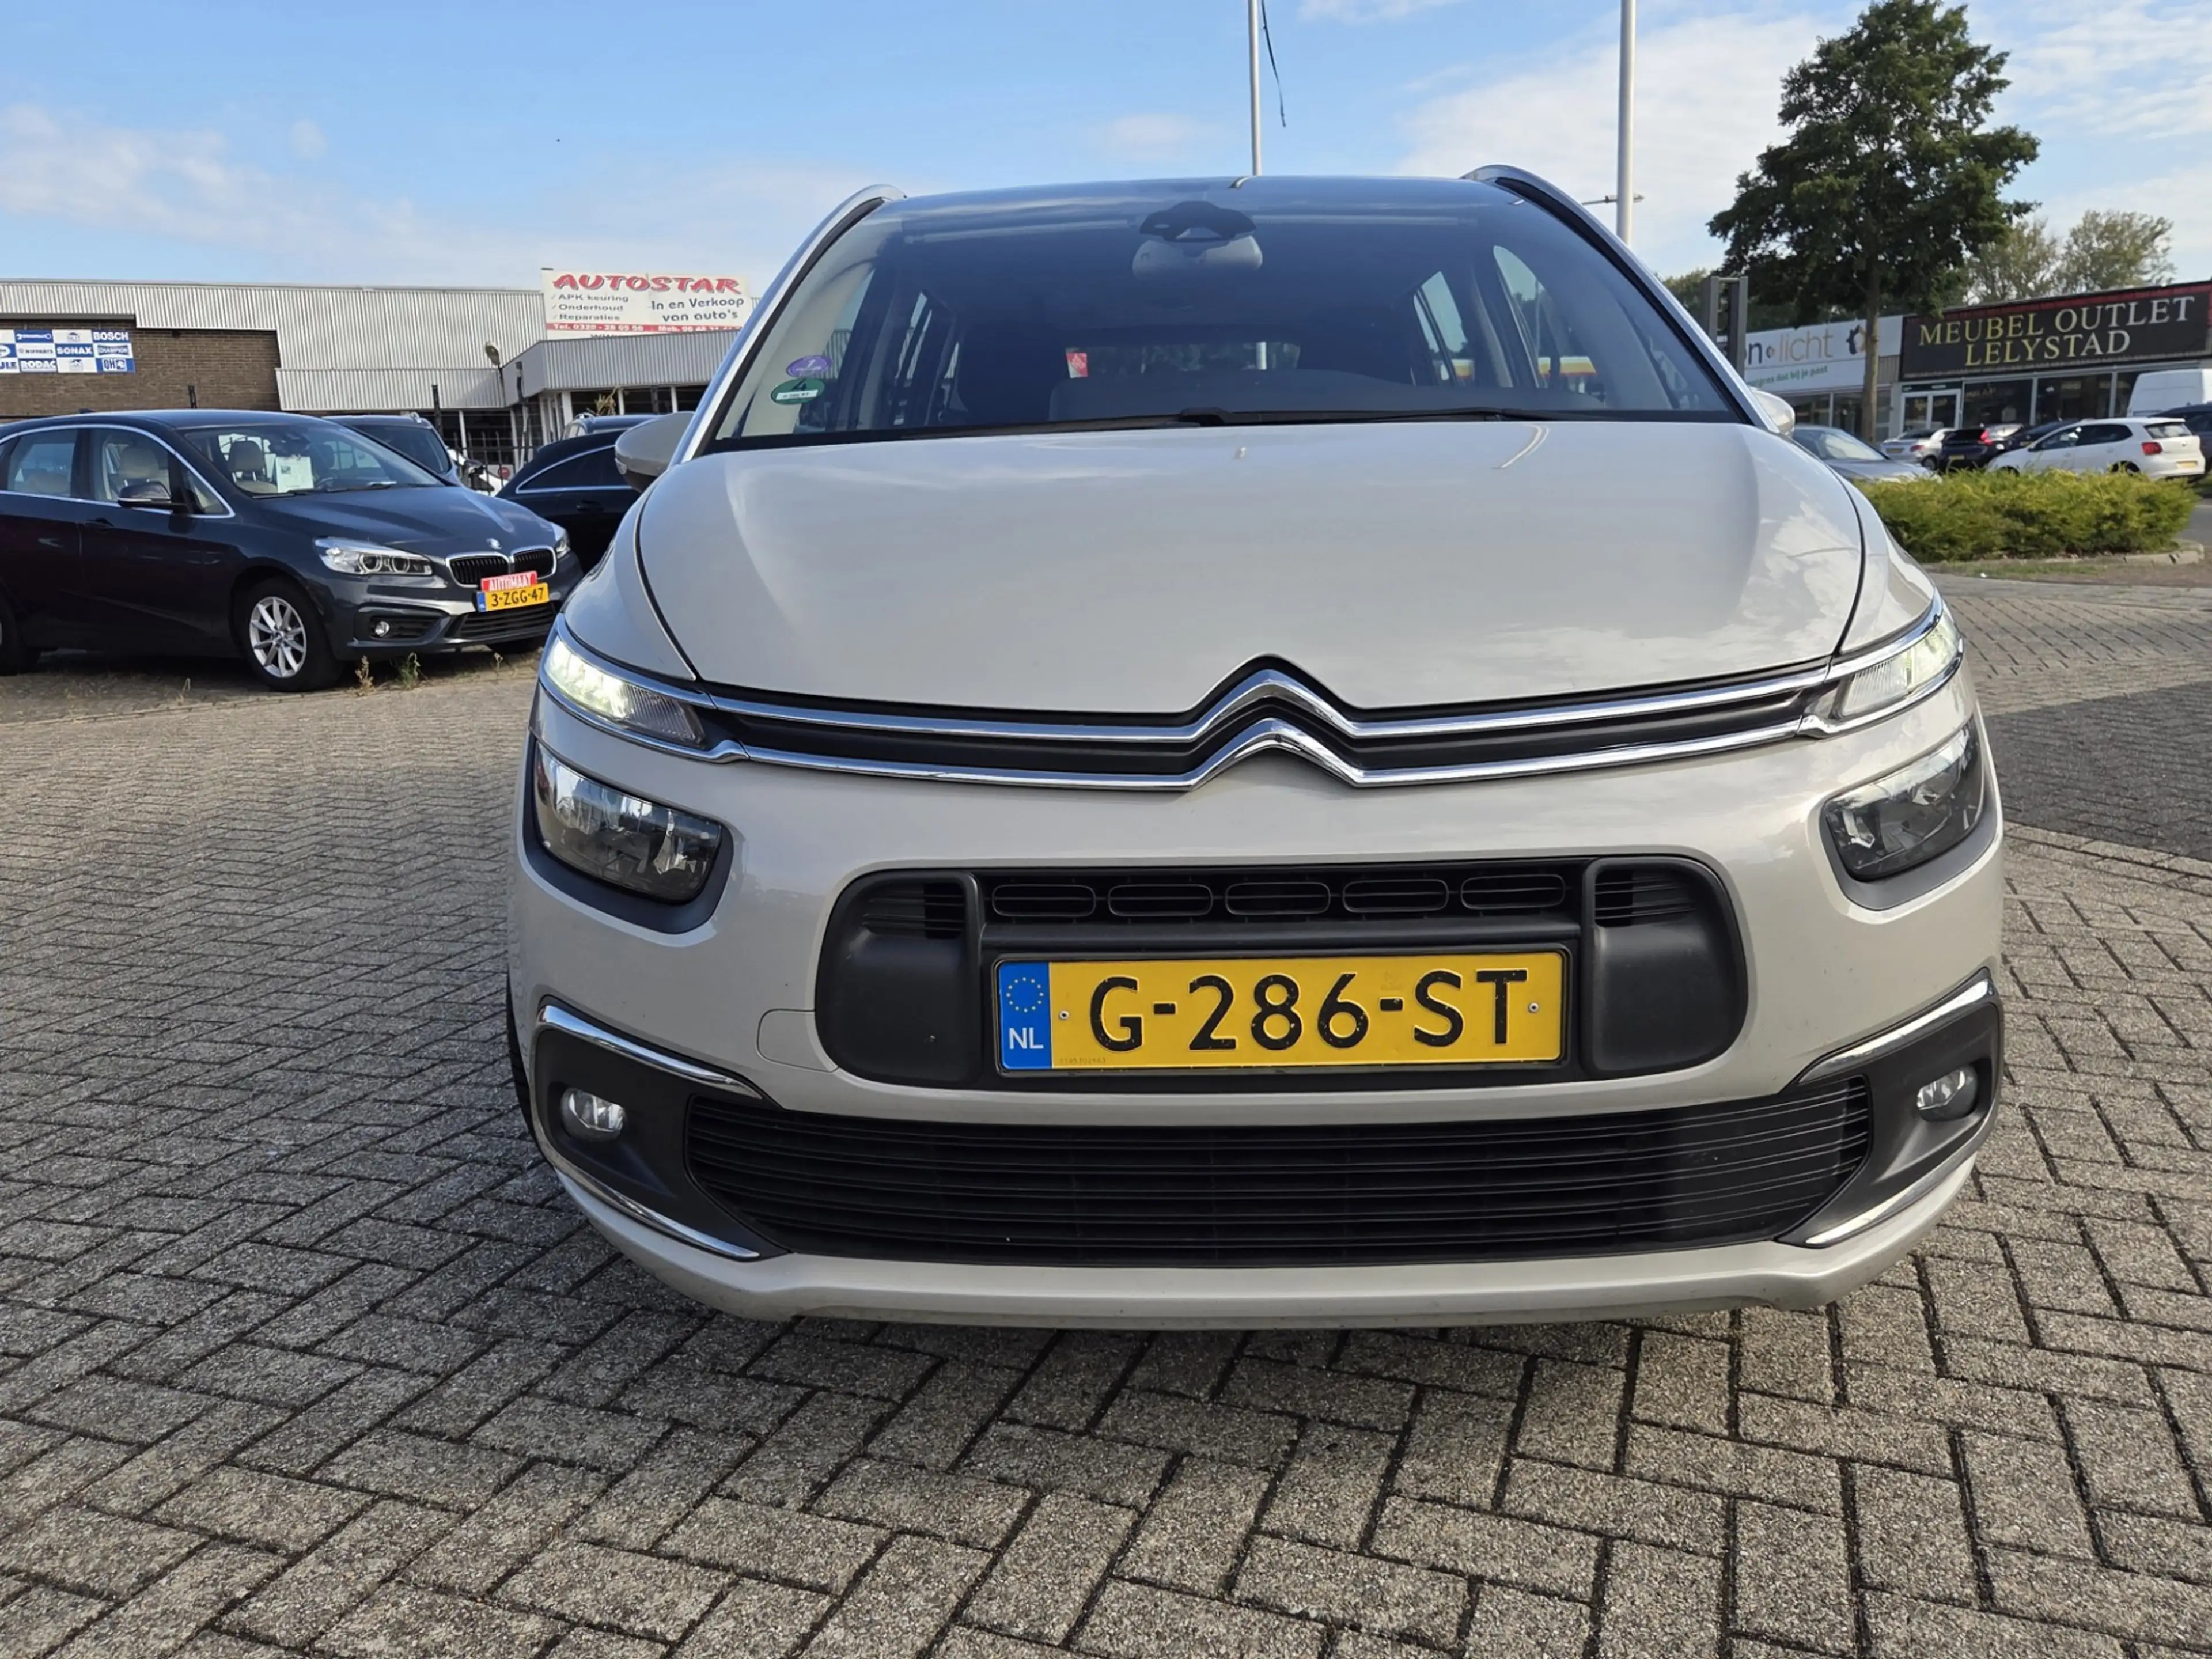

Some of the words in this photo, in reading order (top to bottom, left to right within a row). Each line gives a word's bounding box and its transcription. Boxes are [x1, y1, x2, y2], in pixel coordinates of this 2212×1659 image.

[552, 274, 741, 294] AUTOSTAR
[588, 294, 629, 302] keuring
[652, 301, 664, 310] In
[689, 297, 744, 308] Verkoop
[662, 314, 689, 322] van
[694, 310, 738, 320] auto's
[1919, 313, 2044, 346] MEUBEL
[2055, 296, 2195, 333] OUTLET
[93, 332, 128, 340] BOSCH
[1779, 328, 1834, 362] licht
[57, 347, 92, 355] SONAX
[1964, 330, 2130, 366] LELYSTAD
[20, 360, 56, 369] RODAC
[489, 574, 531, 591] AUTOMAAT
[491, 587, 544, 607] 3-ZGG-47
[1090, 968, 1528, 1052] G-286-ST
[1009, 1027, 1044, 1050] NL
